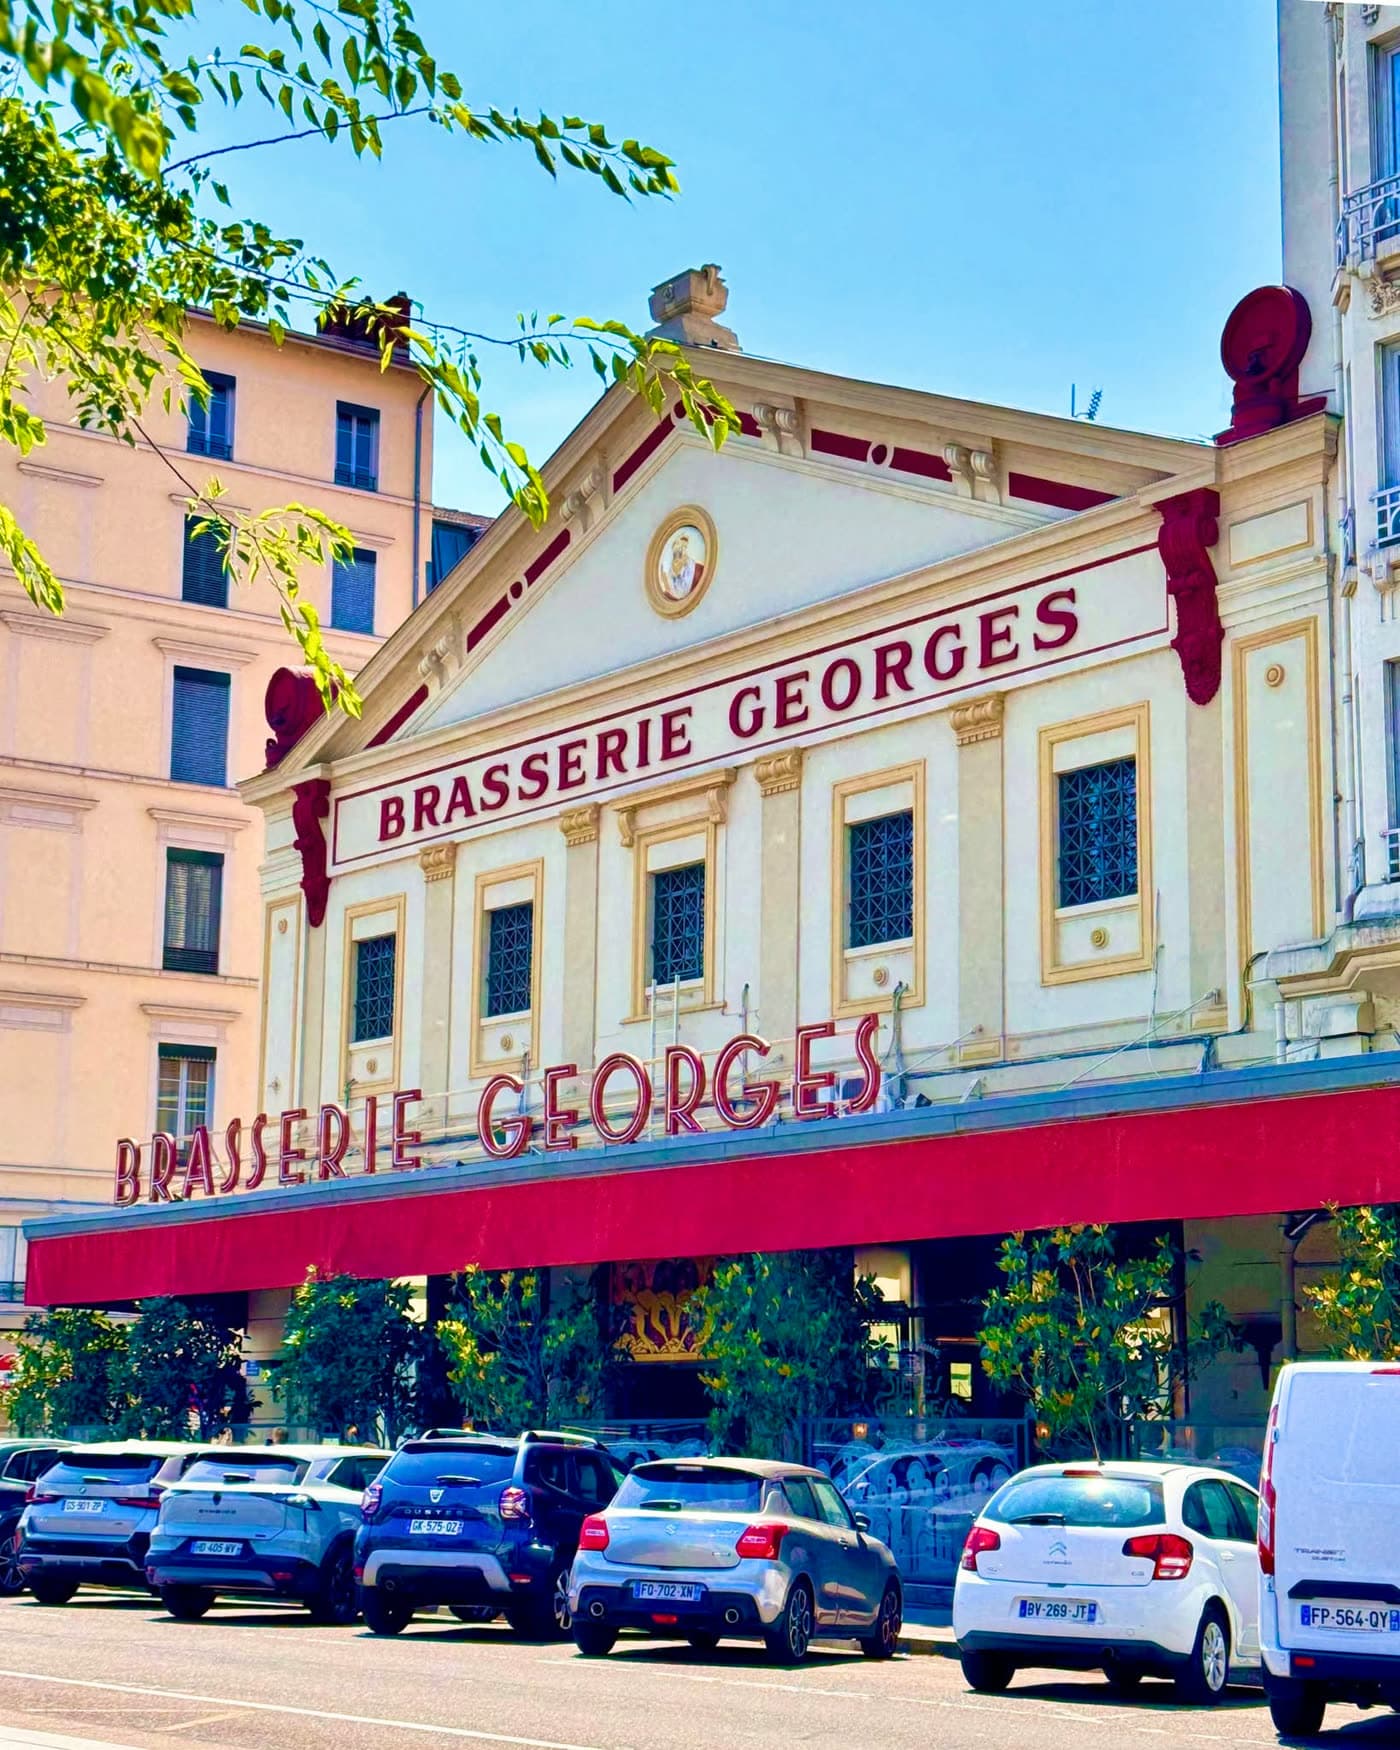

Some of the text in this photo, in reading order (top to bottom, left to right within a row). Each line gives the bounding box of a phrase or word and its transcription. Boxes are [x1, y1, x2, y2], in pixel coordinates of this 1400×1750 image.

[378, 587, 1079, 842] BRASSERIE GEORGES
[113, 1013, 881, 1208] BRASSERIE GEORGES
[1027, 1602, 1088, 1619] BV-269-JT
[1311, 1607, 1389, 1628] FP-564-QY
